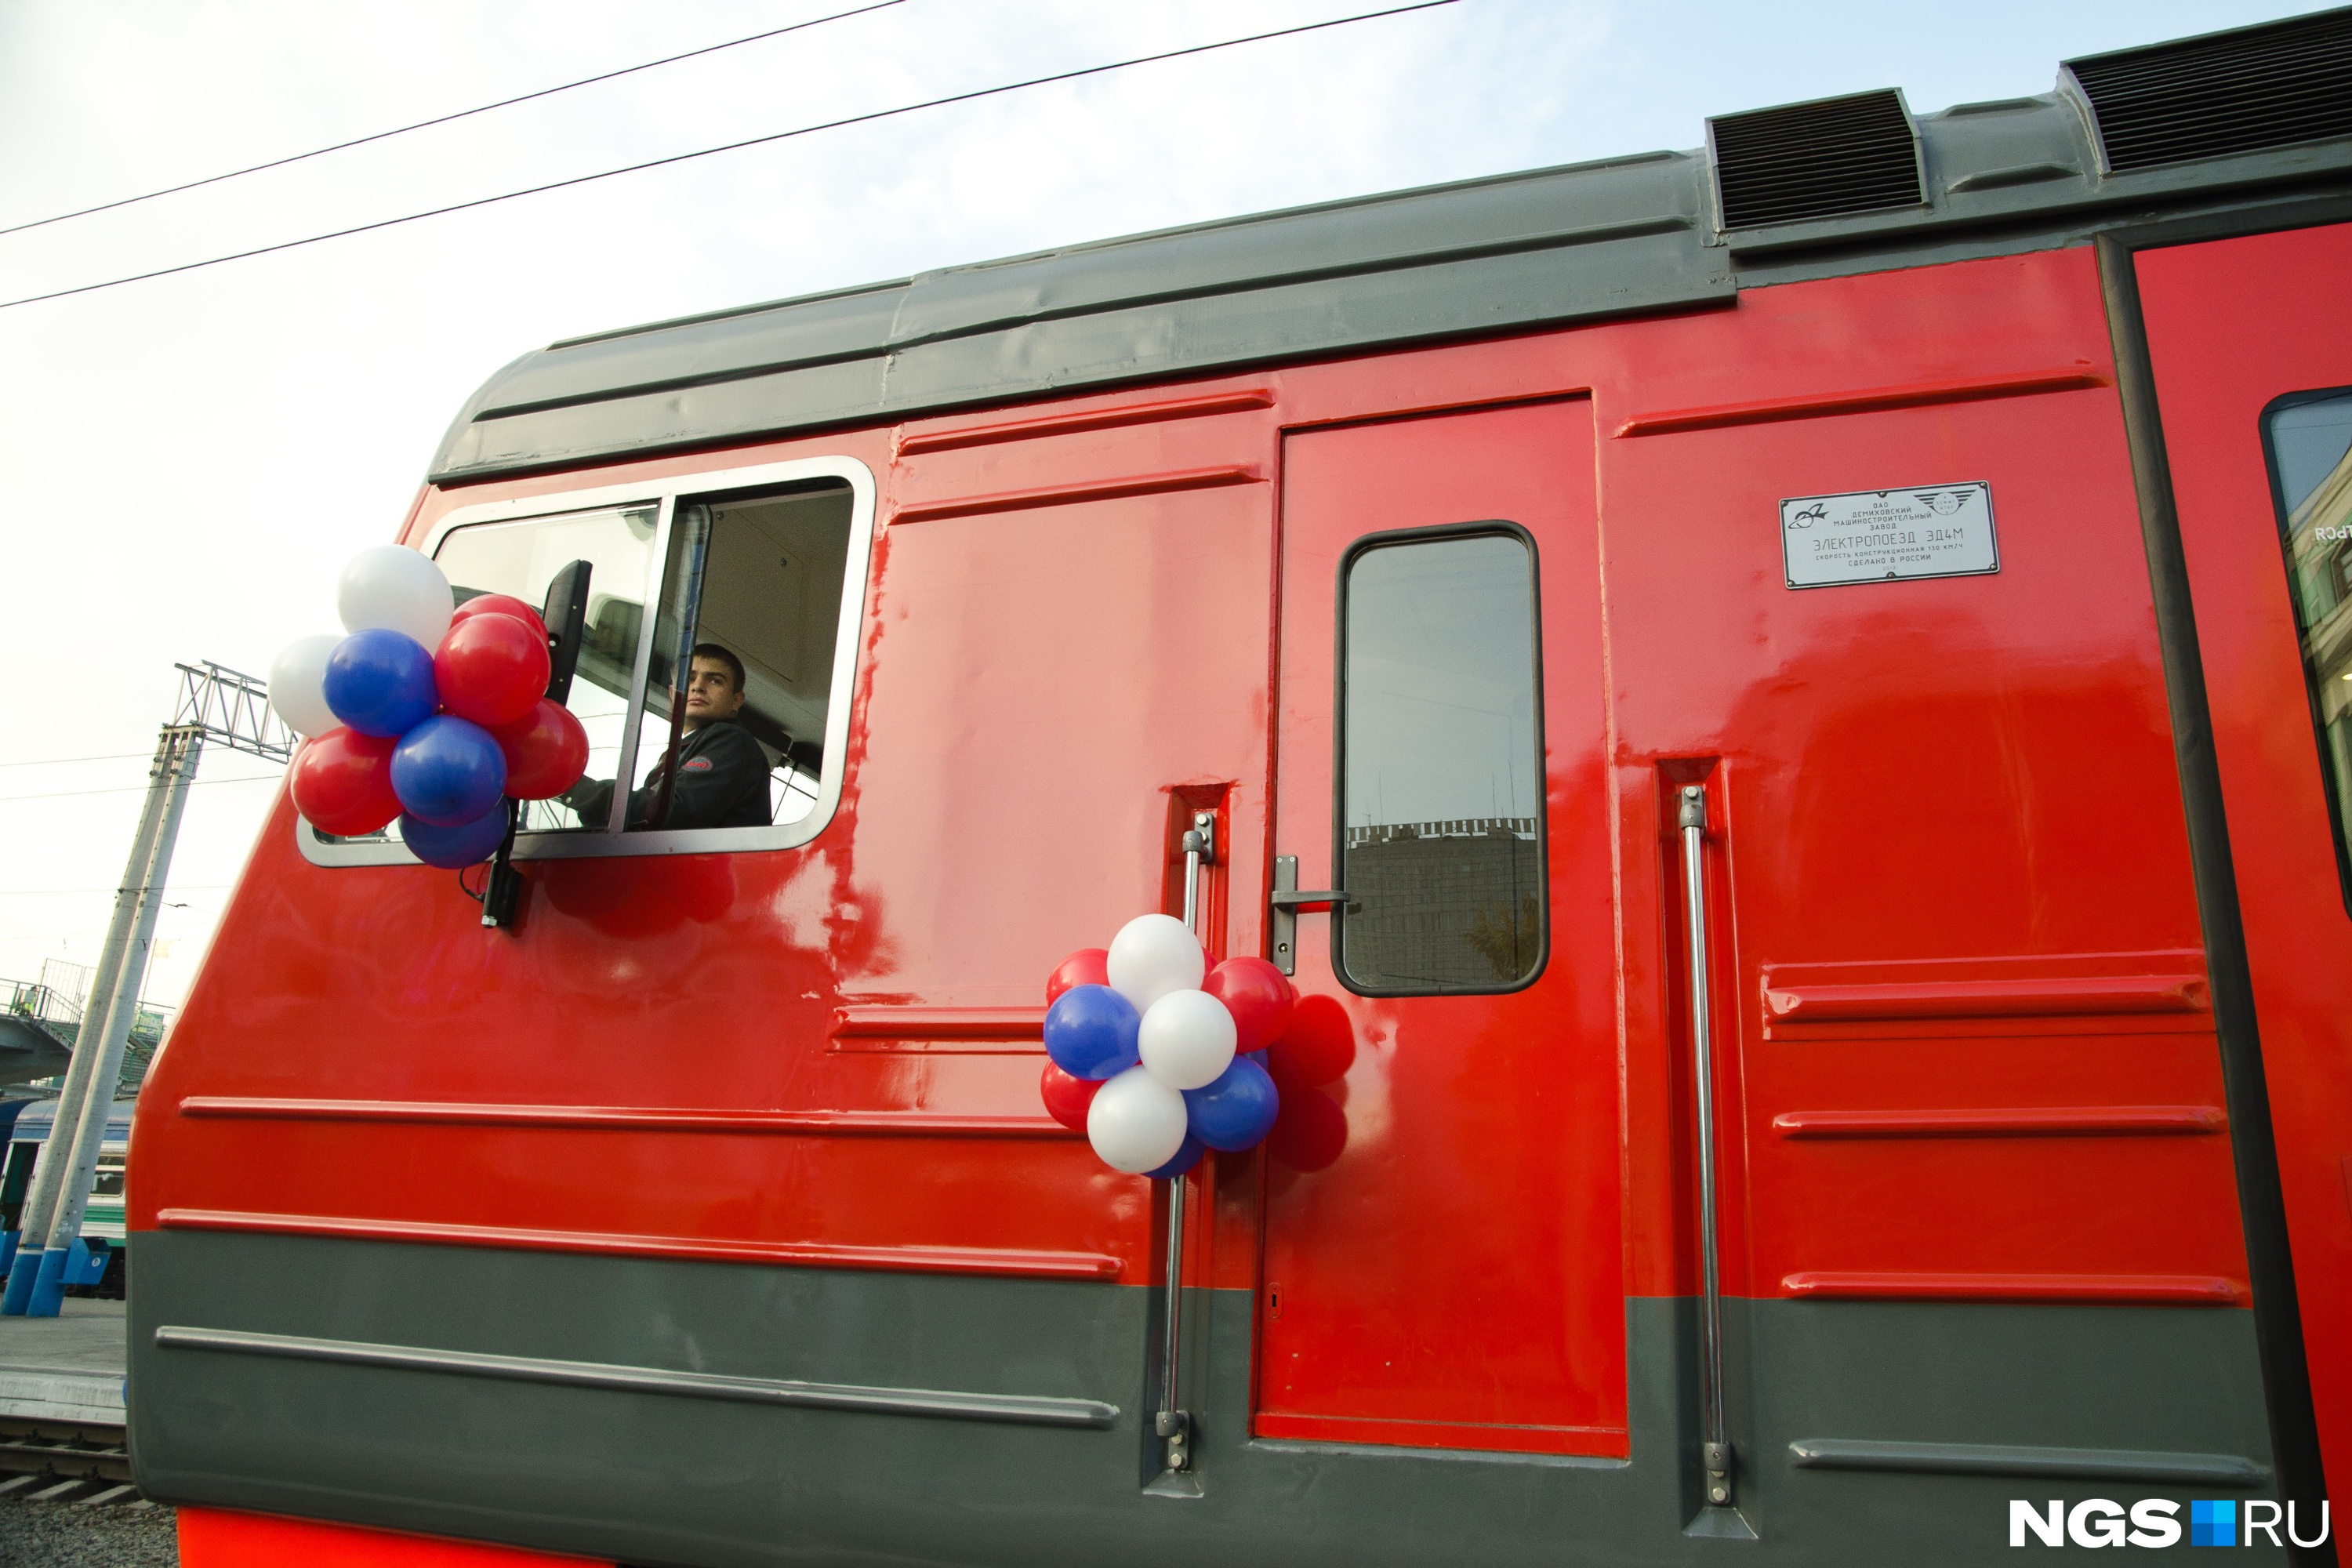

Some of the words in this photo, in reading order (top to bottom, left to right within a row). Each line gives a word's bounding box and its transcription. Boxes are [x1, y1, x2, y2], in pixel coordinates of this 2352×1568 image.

[1834, 511, 1932, 527] МАШИНОСТРОИТЕЛЬНЫЙ
[1852, 506, 1911, 518] ДЕМИХОВСКИЙ
[1813, 532, 1916, 551] ЭЛЕКТРОПОЕЗД
[1926, 528, 1964, 542] ЭД4М
[1816, 552, 1851, 561] СКОРОСТЬ
[1855, 546, 1925, 557] КОНСТРУКЦИОННАЯ
[1848, 557, 1886, 567] СДЕЛАНО
[1900, 554, 1931, 563] РОССИИ
